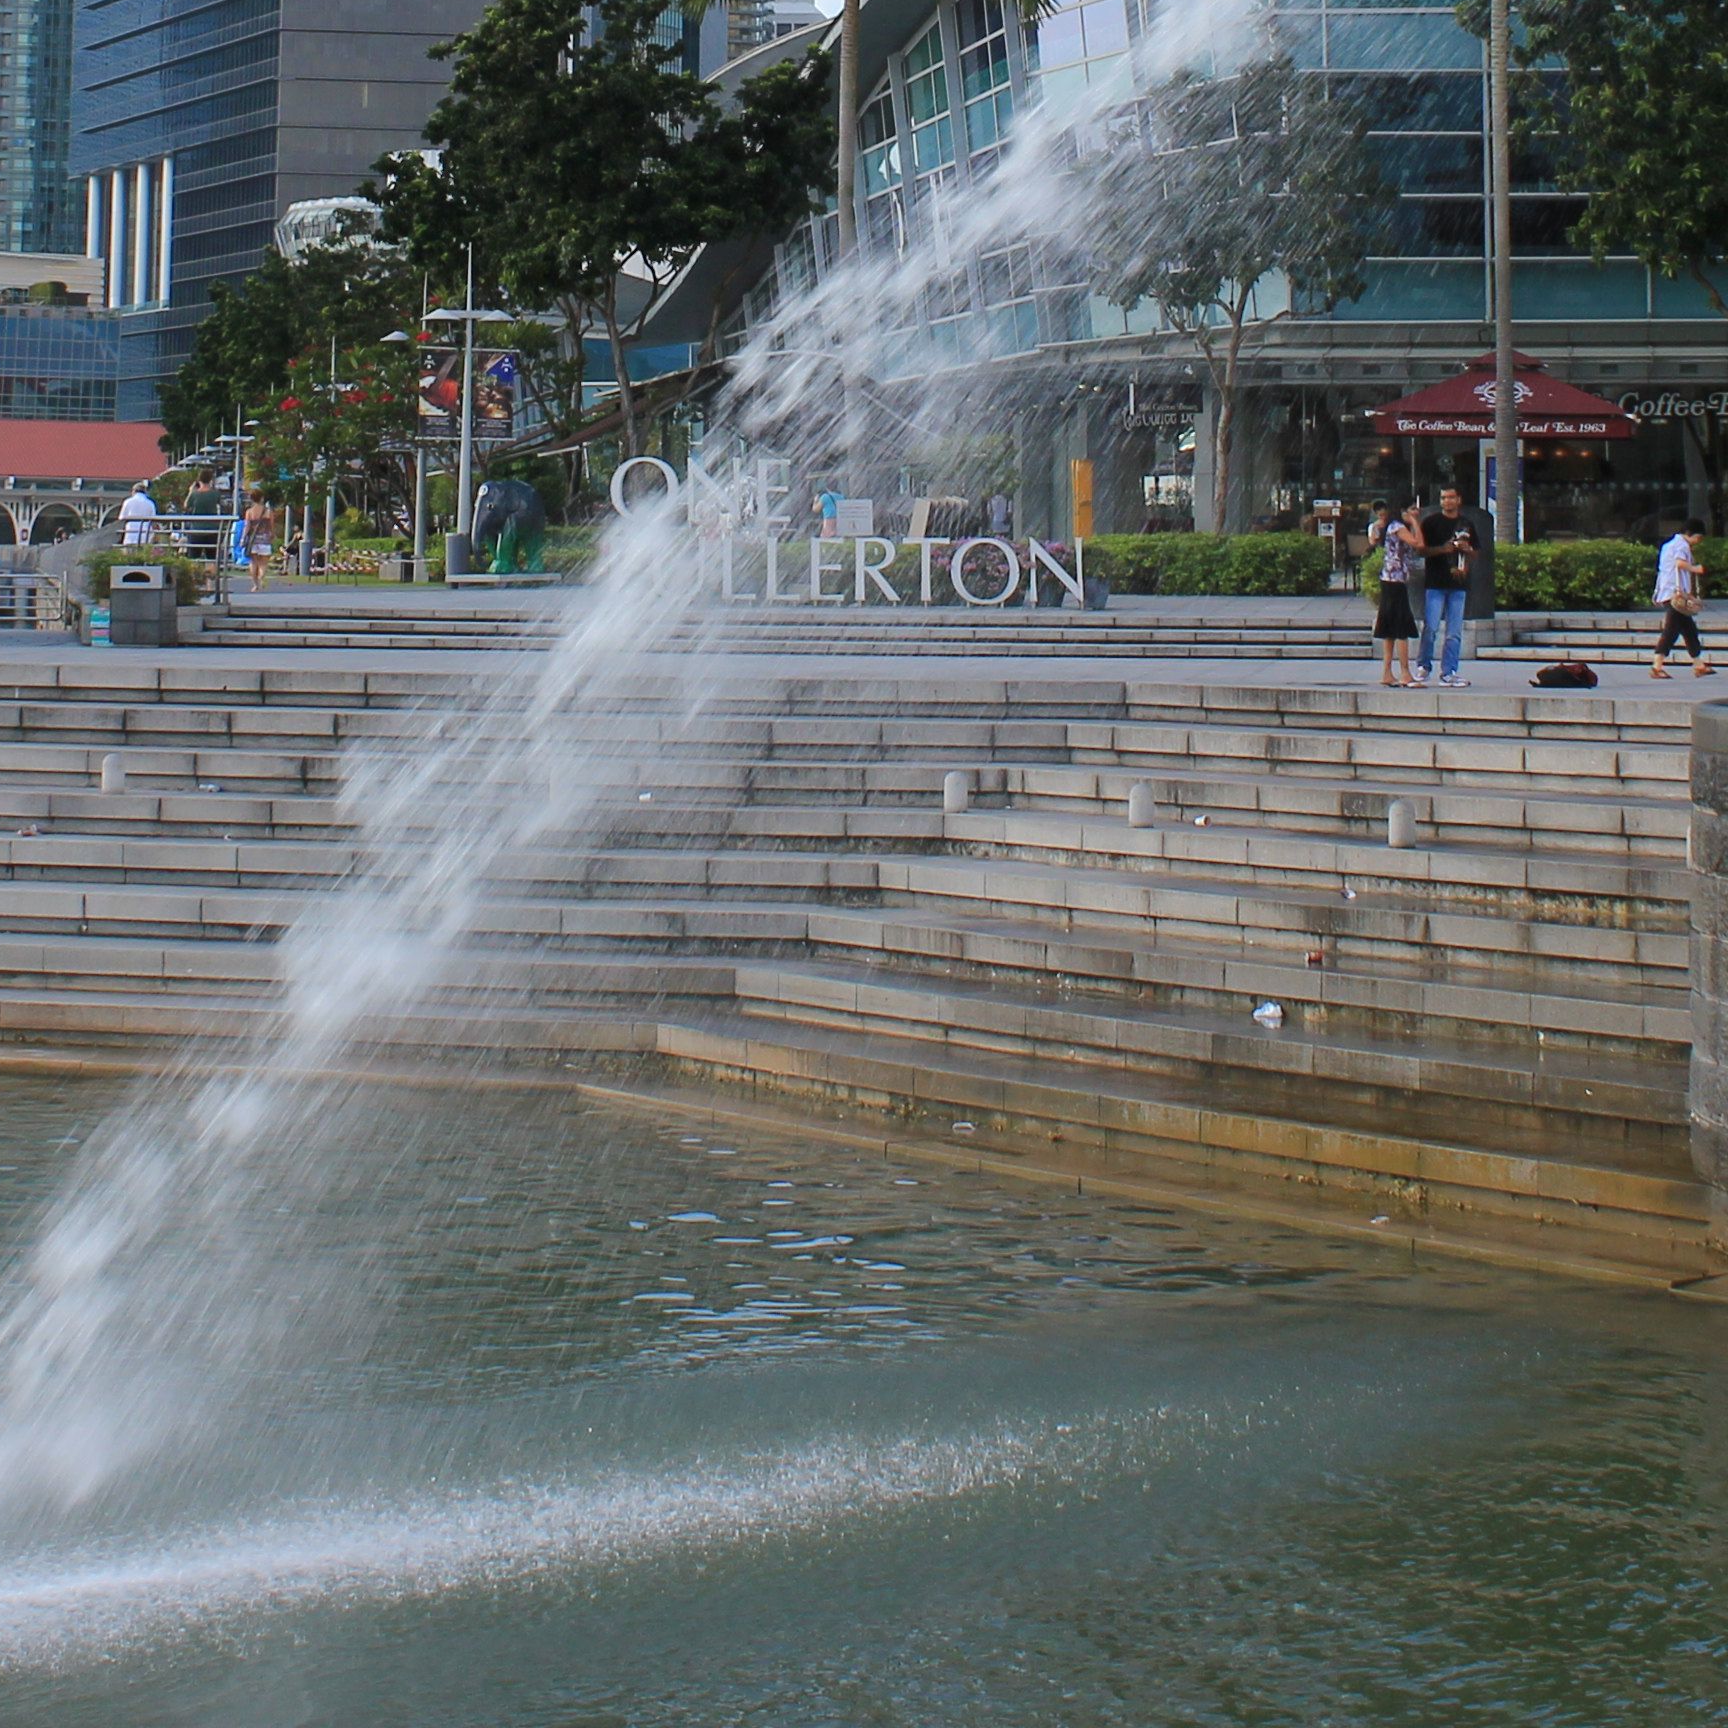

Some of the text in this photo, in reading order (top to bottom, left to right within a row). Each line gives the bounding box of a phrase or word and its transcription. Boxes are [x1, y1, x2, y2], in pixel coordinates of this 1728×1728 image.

[1617, 392, 1705, 417] Coffee
[1396, 419, 1417, 432] The
[1418, 420, 1453, 432] Coffee
[1453, 419, 1485, 433] Bean
[1519, 420, 1548, 434] Leaf
[1578, 420, 1606, 434] 1963
[610, 456, 791, 524] ONE
